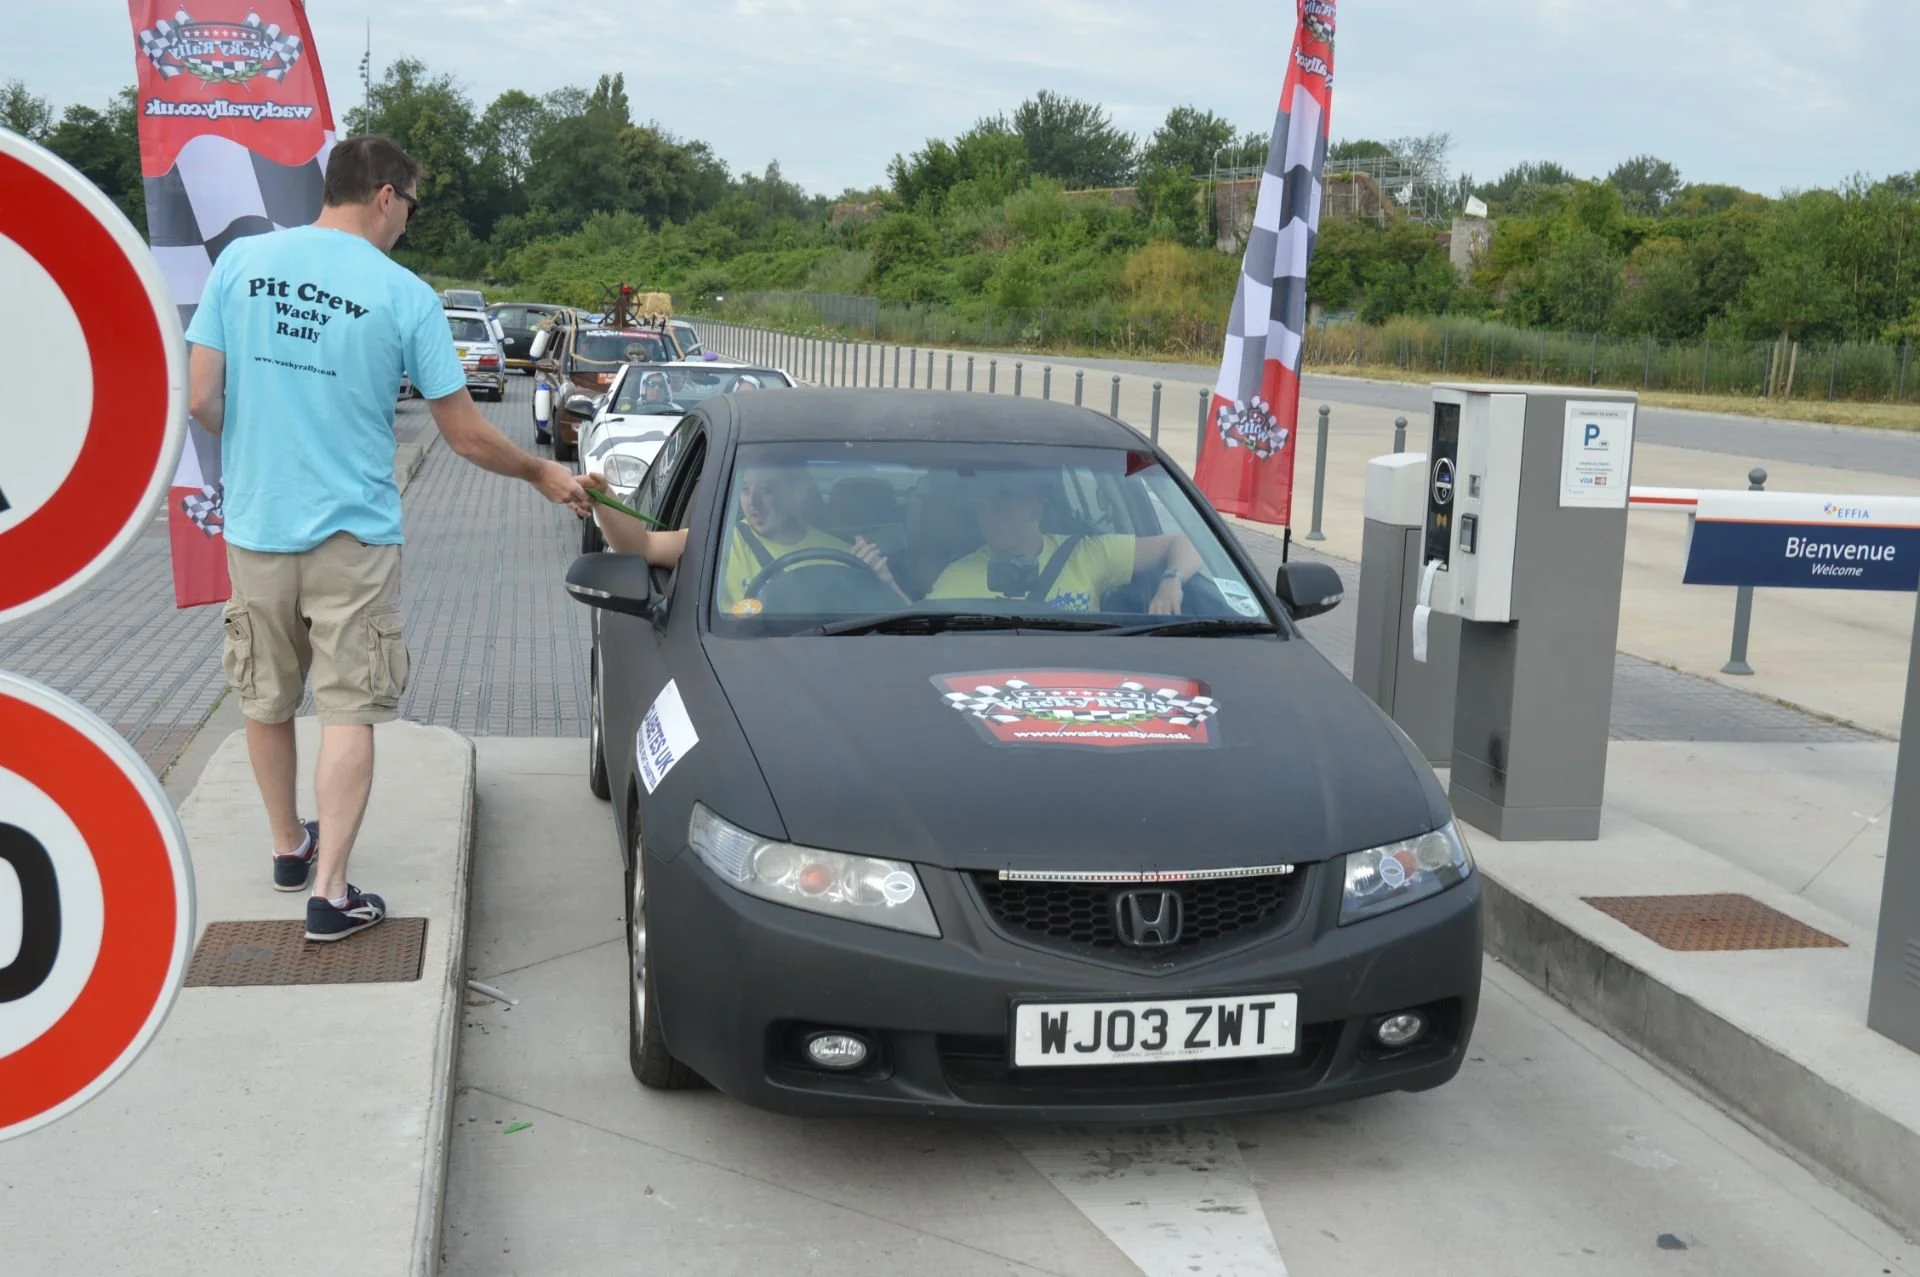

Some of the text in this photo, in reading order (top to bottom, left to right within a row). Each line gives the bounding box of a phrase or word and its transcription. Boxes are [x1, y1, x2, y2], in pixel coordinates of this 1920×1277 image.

[248, 277, 370, 320] Pit Crew
[275, 301, 332, 326] Wacky
[276, 321, 320, 343] Rally
[1837, 507, 1870, 520] EFFIA
[1784, 536, 1896, 561] Bienvenue
[1811, 563, 1864, 577] Welcome
[1013, 730, 1191, 740] www.wackyrally.co.uk
[654, 745, 675, 777] UK
[1040, 1002, 1276, 1054] WJ03 ZWT
